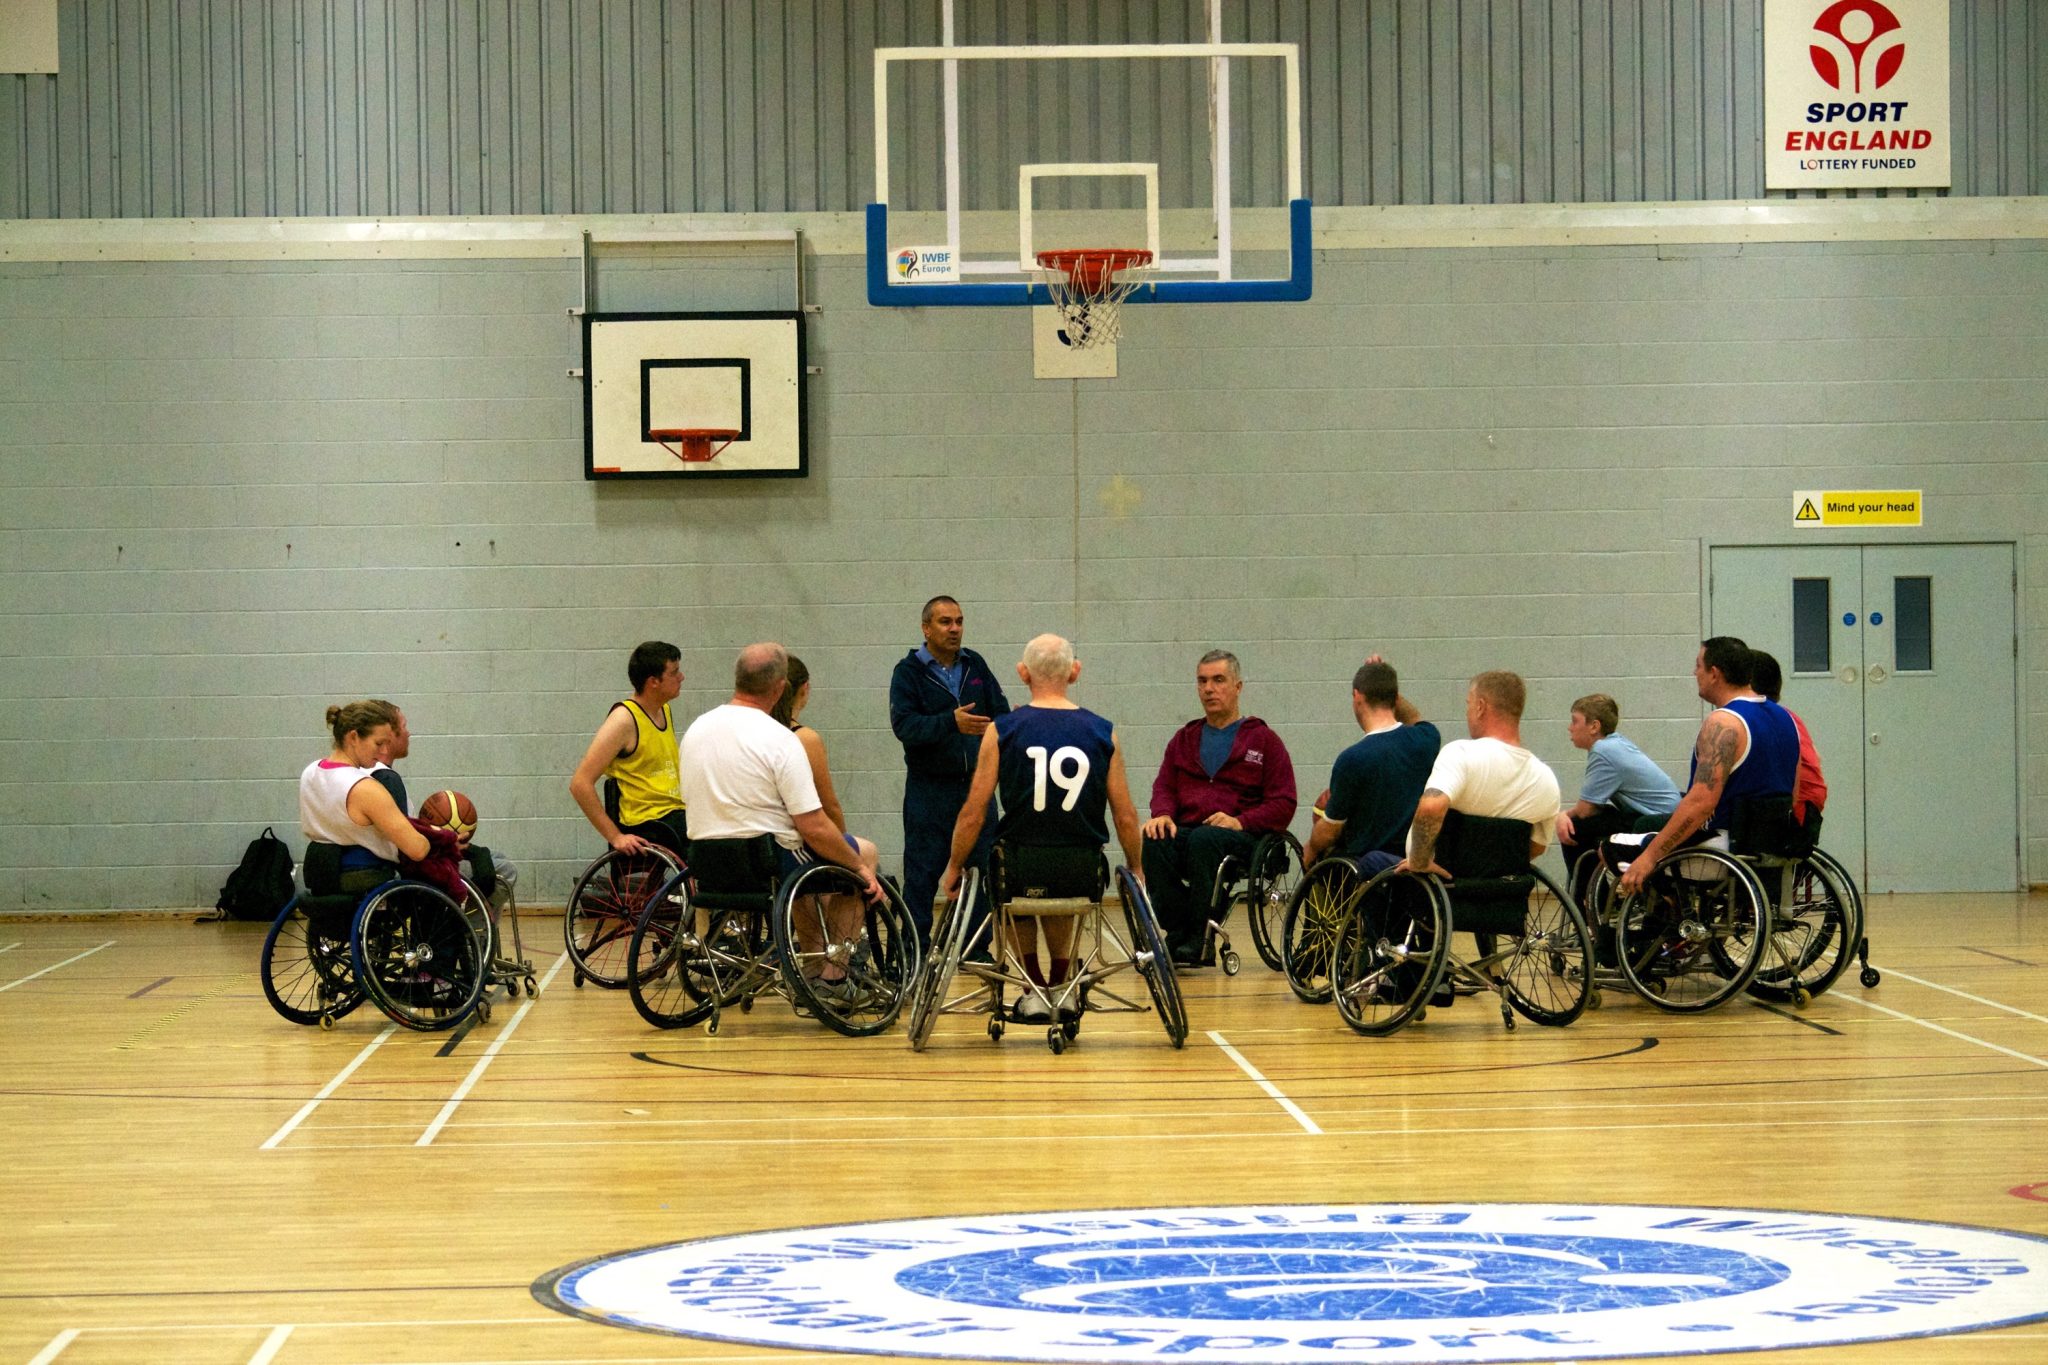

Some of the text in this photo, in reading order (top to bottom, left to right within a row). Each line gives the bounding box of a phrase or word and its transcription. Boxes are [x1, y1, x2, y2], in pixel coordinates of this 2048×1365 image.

[1806, 102, 1908, 123] SPORT
[1785, 130, 1932, 151] ENGLAND
[1800, 158, 1916, 170] LOTTERY FUNDED
[921, 253, 951, 263] IWBF
[922, 265, 952, 274] Europe
[1827, 502, 1915, 514] Mind your head
[1026, 746, 1090, 812] 19
[666, 1212, 1600, 1356] British Wheelchair Sport
